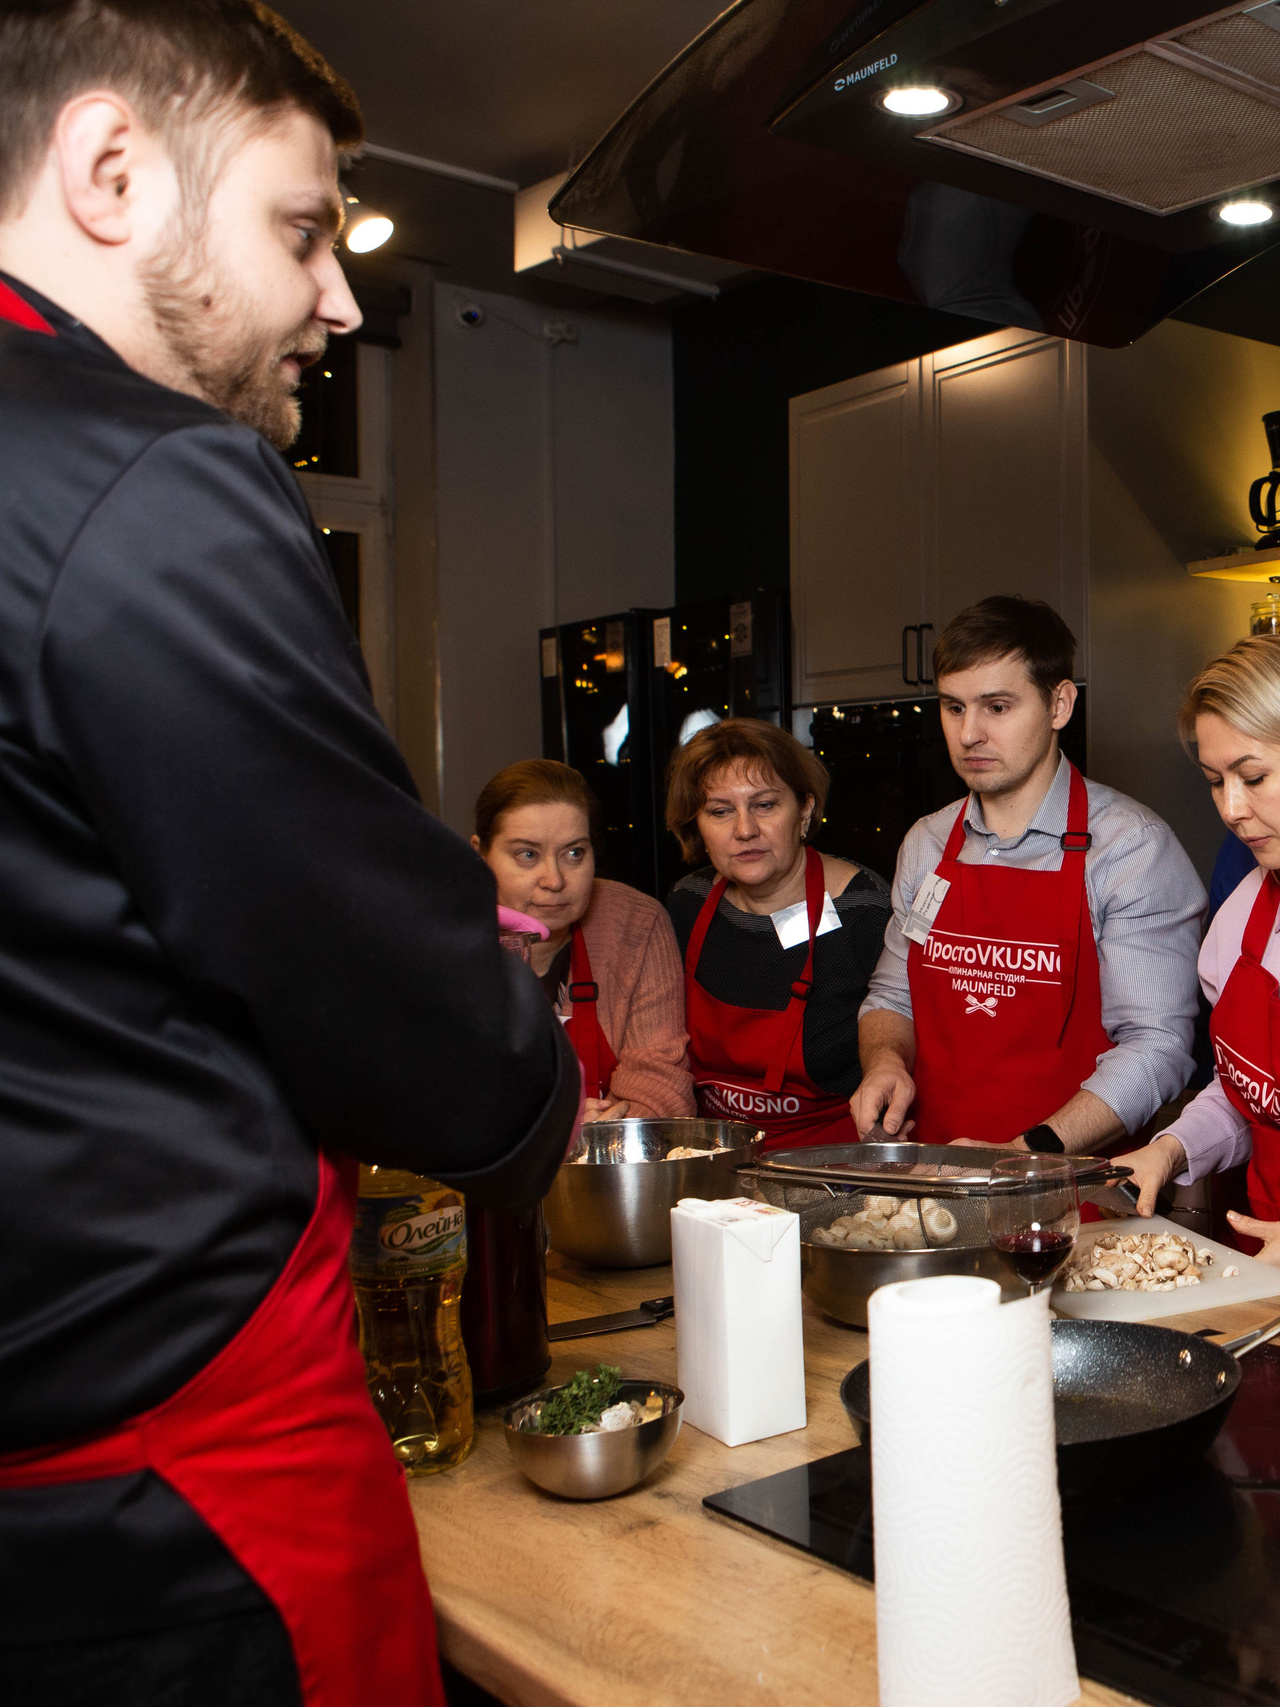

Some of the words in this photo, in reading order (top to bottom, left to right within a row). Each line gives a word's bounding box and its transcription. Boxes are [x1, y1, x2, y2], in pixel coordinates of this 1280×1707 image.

[846, 53, 898, 86] MAUNFELD
[952, 978, 1017, 998] MAUNFELD
[994, 971, 1026, 984] СТУДИЯ
[388, 1209, 463, 1248] Олейна
